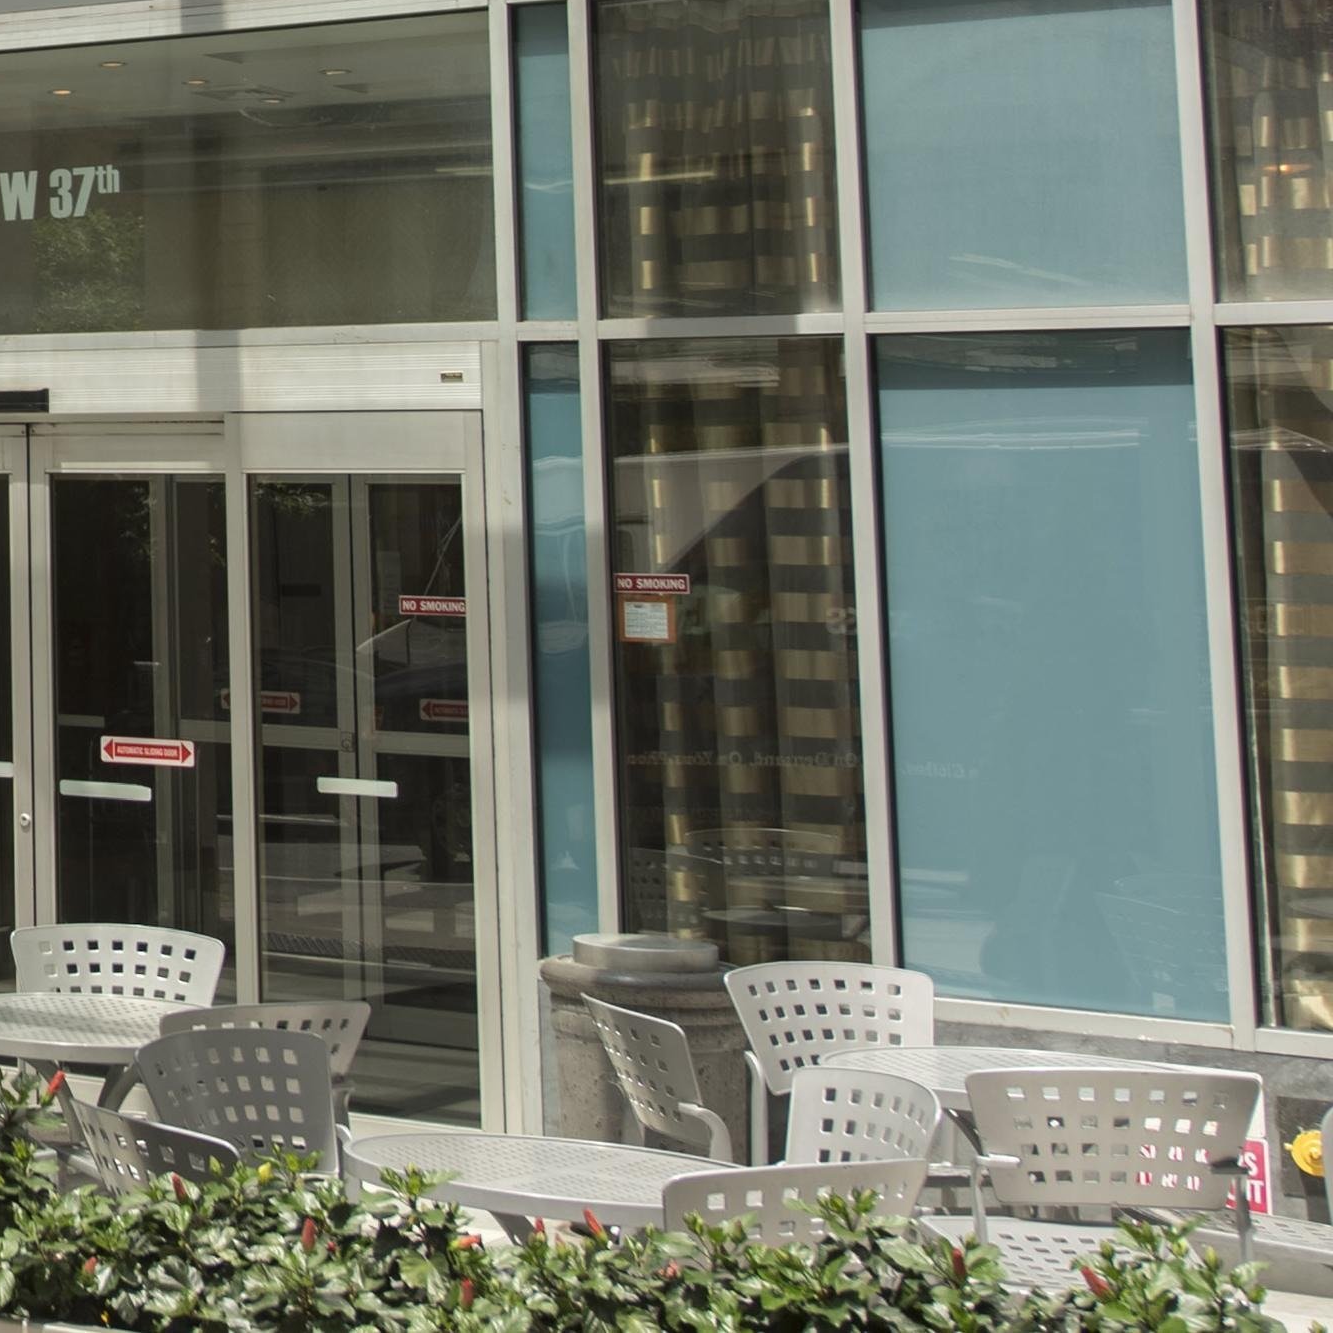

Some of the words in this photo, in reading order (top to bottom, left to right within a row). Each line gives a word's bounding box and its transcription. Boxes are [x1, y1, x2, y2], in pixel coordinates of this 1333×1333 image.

[0, 171, 38, 221] W
[49, 164, 120, 218] 37th
[617, 578, 633, 588] NO
[636, 578, 686, 590] SMOKING
[402, 600, 416, 610] NO
[420, 601, 465, 612] SMOKING
